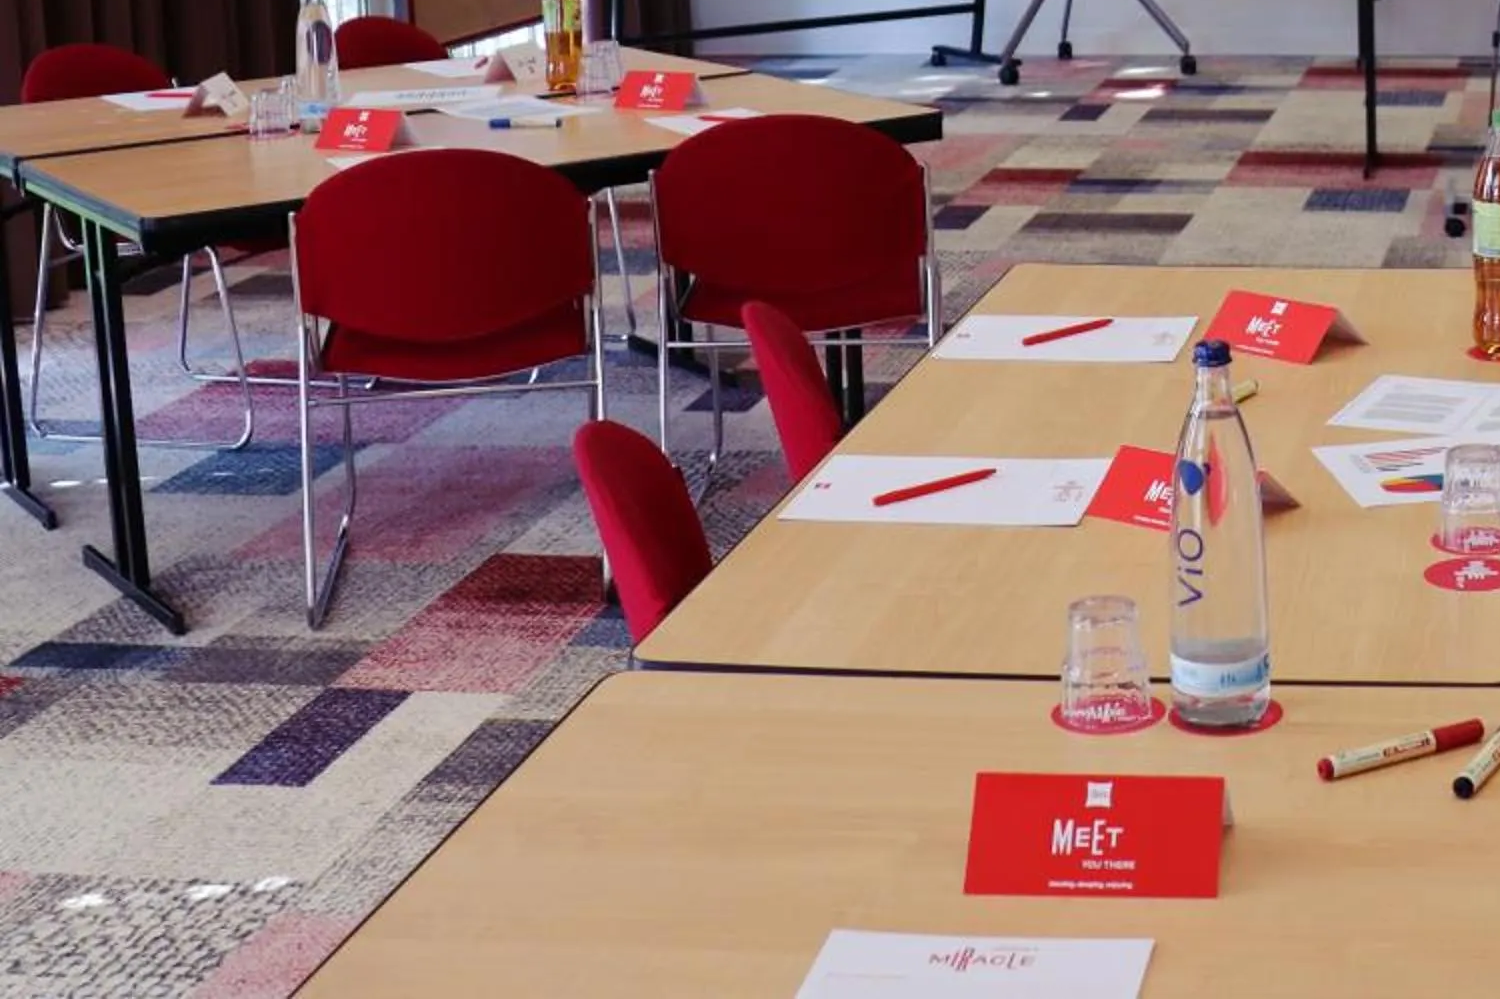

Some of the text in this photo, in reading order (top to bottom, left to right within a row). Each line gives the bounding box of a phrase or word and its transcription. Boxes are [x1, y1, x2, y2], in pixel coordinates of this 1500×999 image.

[1051, 818, 1124, 855] MEET
[1082, 859, 1135, 870] YOU THERE
